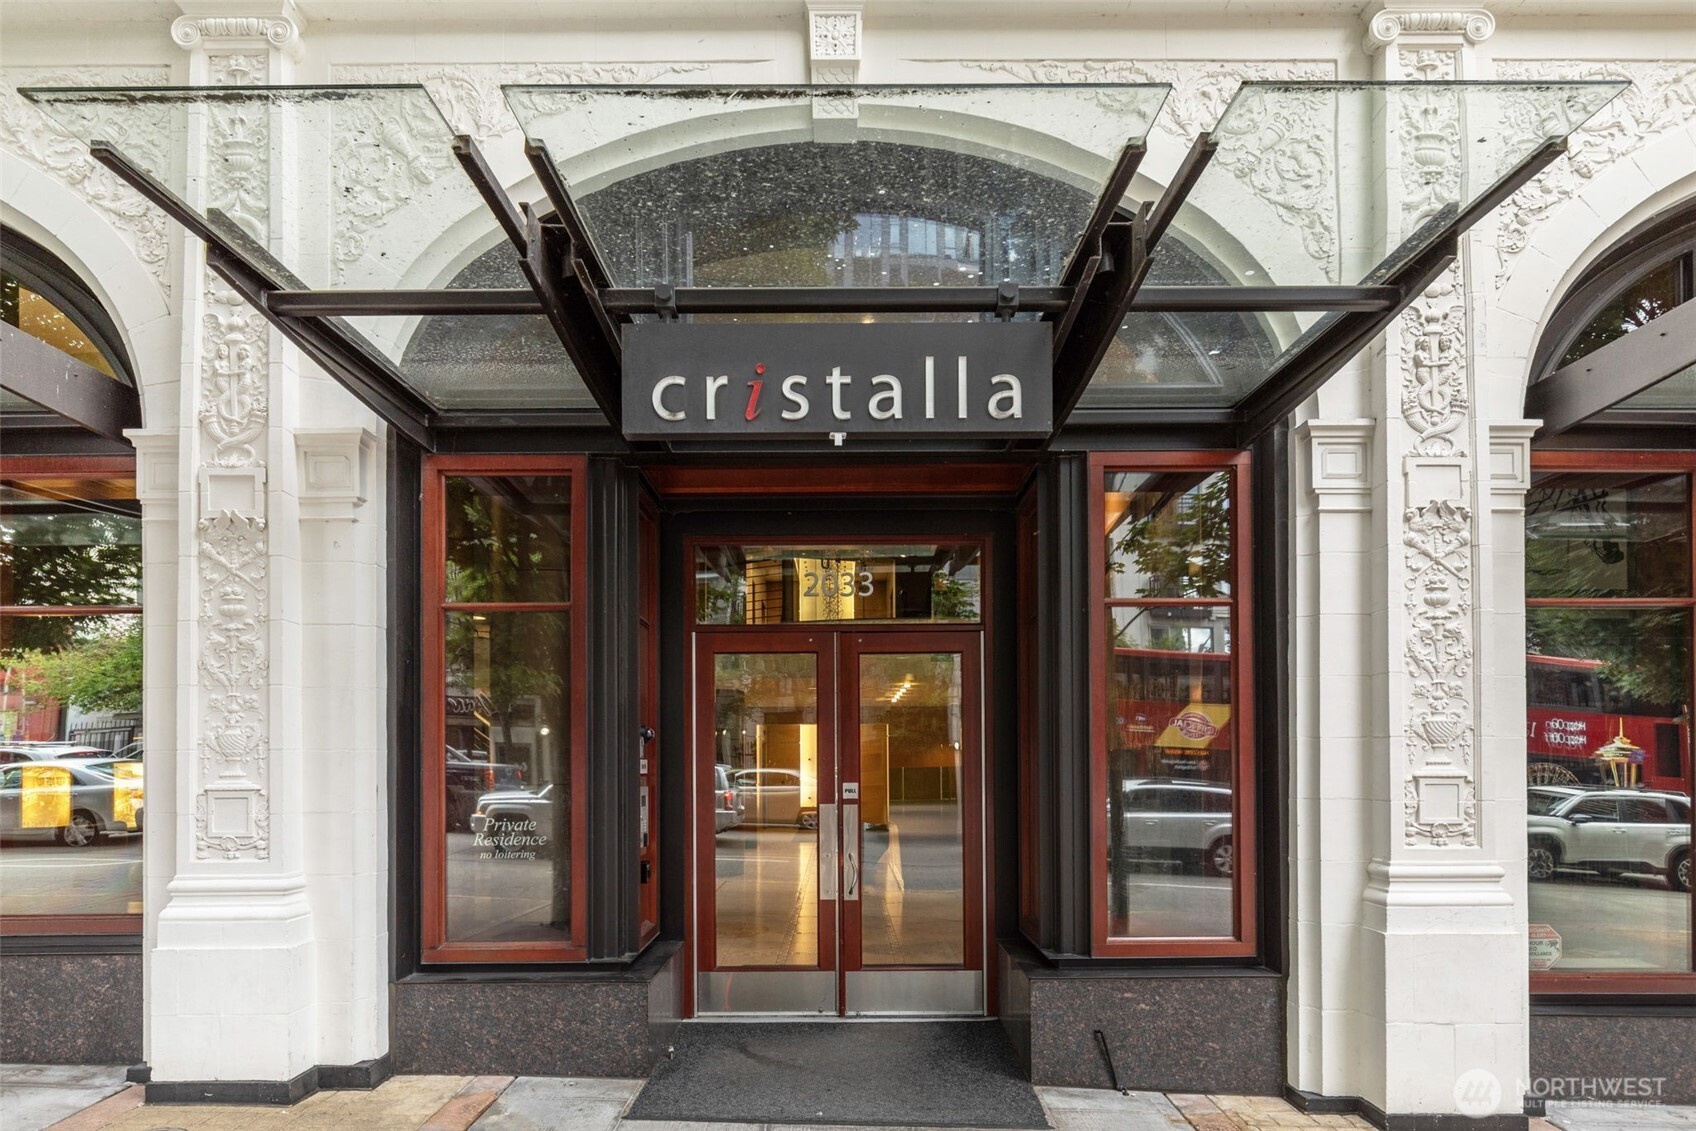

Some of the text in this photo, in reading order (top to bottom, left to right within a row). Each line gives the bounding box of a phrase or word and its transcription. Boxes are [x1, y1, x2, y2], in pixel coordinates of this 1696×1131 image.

[651, 355, 1023, 421] cristalla
[803, 571, 875, 598] 2033
[483, 817, 537, 831] Private
[473, 832, 547, 847] Residence
[480, 849, 536, 861] no loitering
